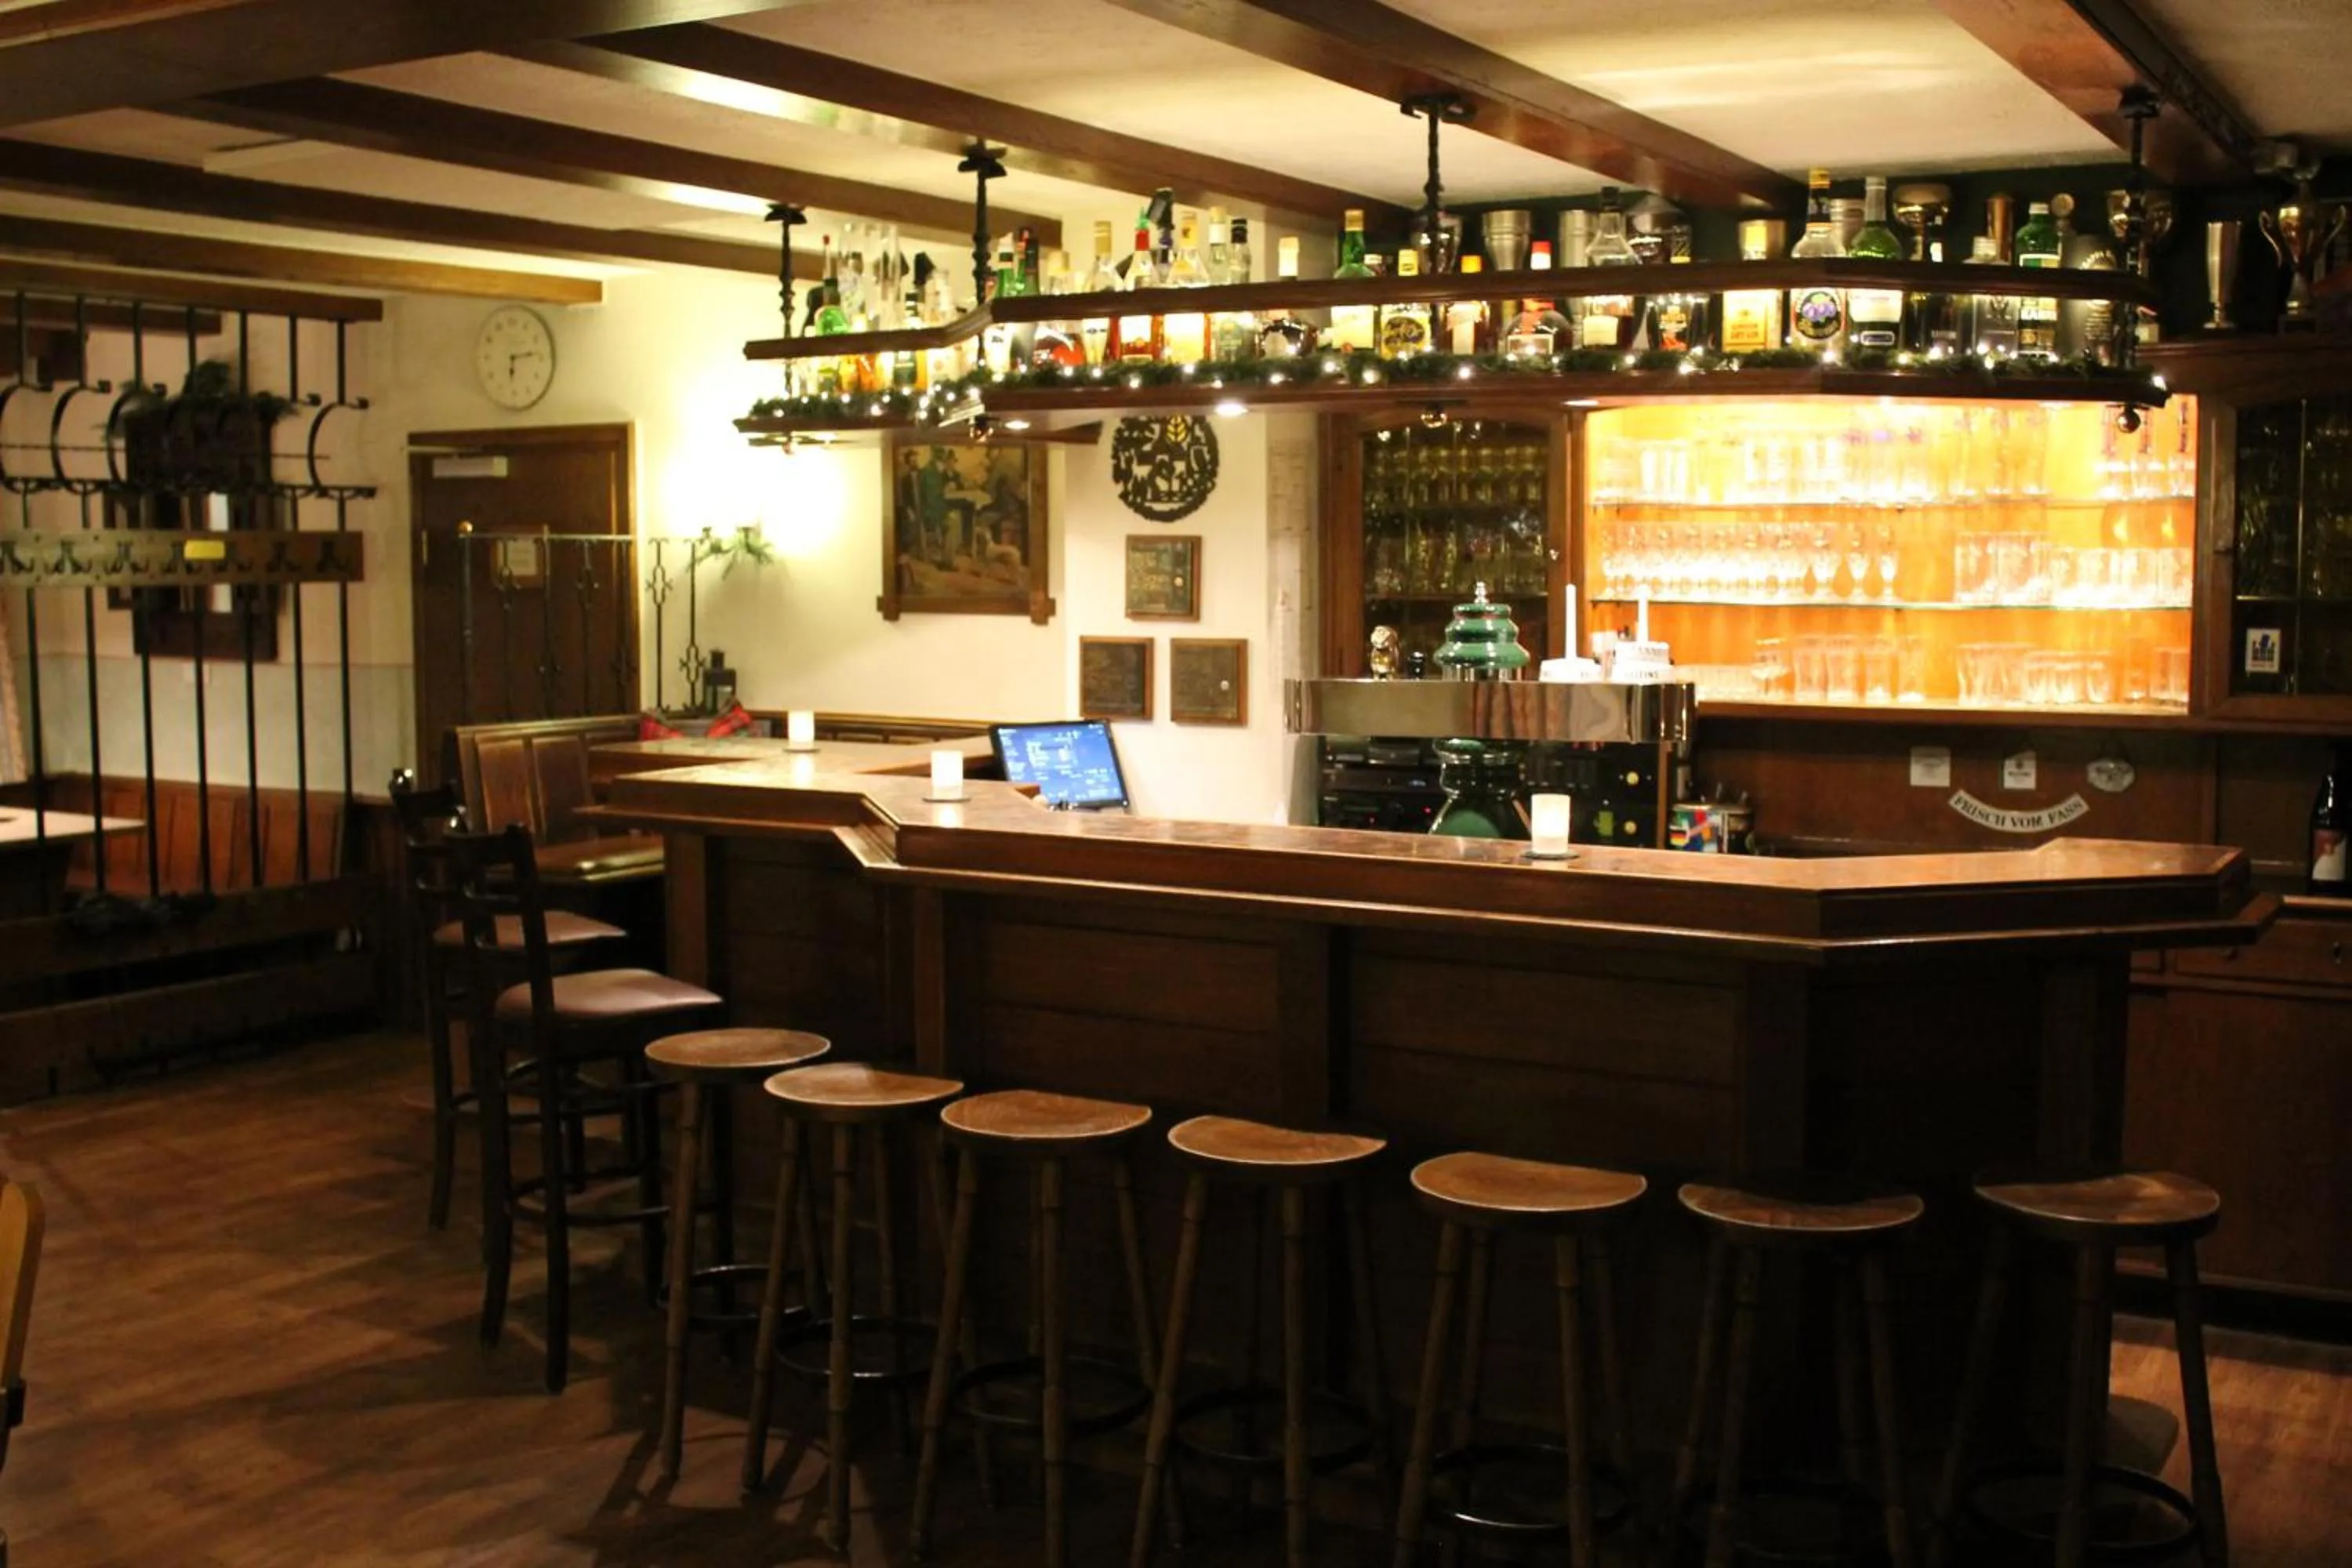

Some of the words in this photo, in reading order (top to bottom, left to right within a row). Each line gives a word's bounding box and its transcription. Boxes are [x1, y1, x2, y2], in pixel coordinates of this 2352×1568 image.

[1954, 795, 2006, 827] FRISCH
[2010, 815, 2042, 828] VOM
[2047, 800, 2083, 823] FASS
